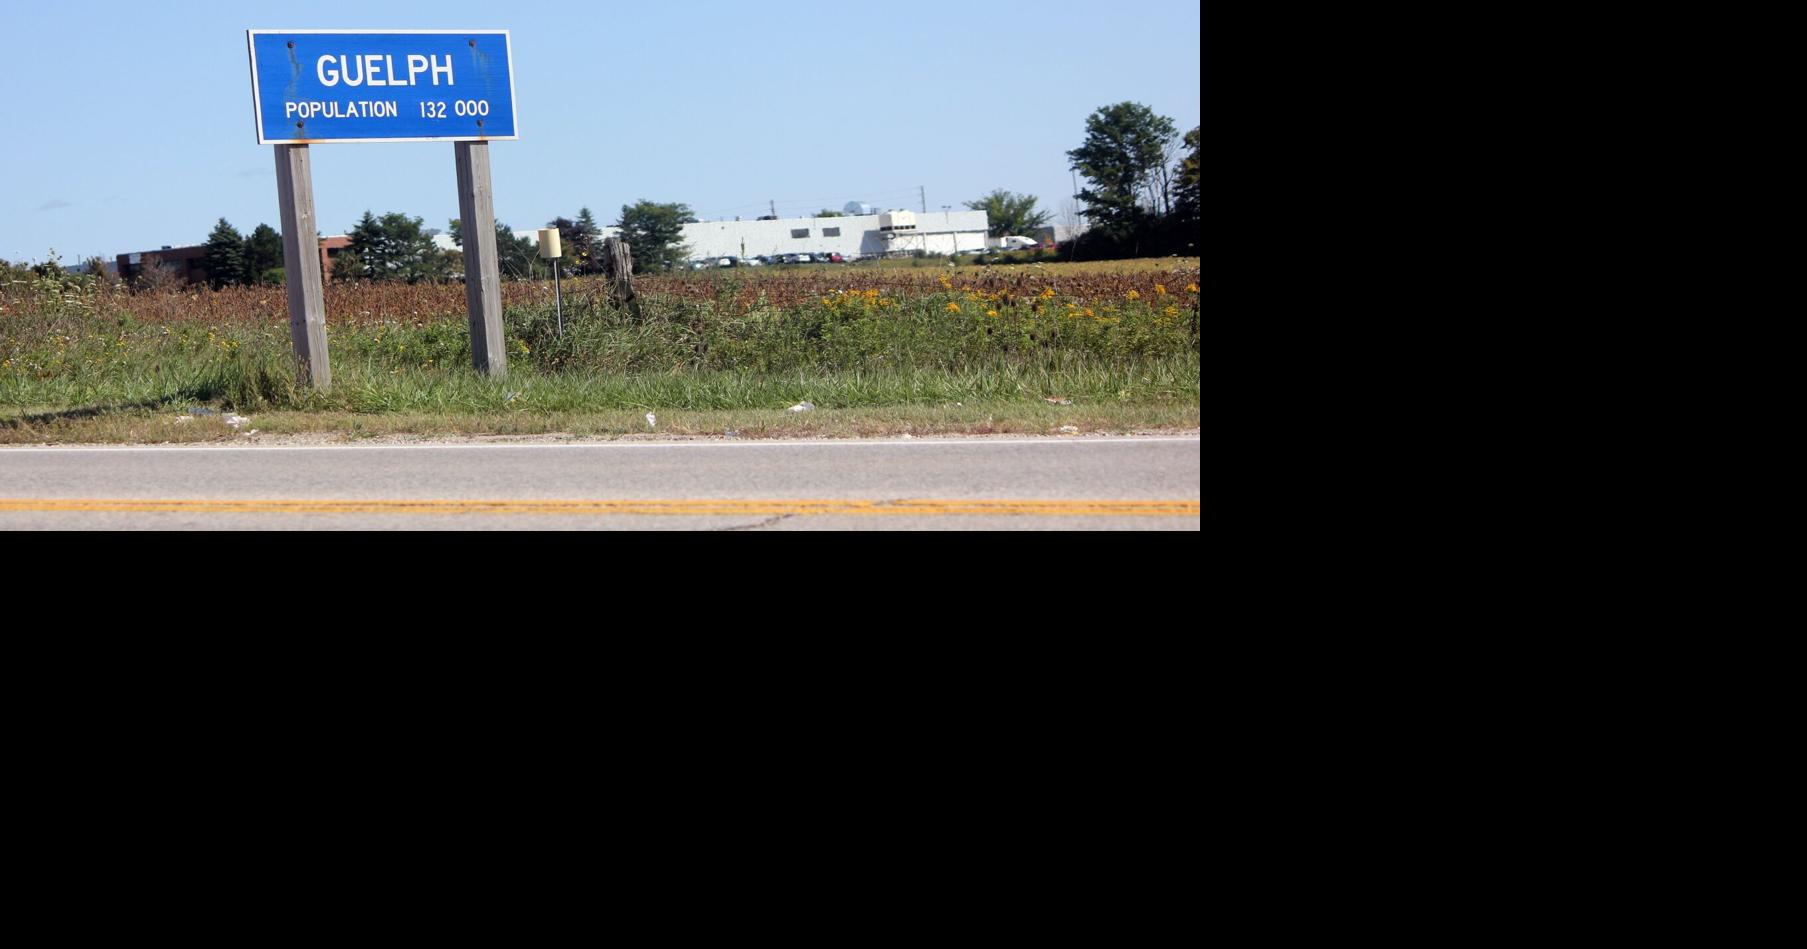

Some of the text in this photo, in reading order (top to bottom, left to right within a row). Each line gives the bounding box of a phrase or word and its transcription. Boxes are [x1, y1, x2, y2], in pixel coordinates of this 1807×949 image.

[316, 54, 455, 87] GUELPH
[285, 100, 490, 119] POPULATION 132 000
